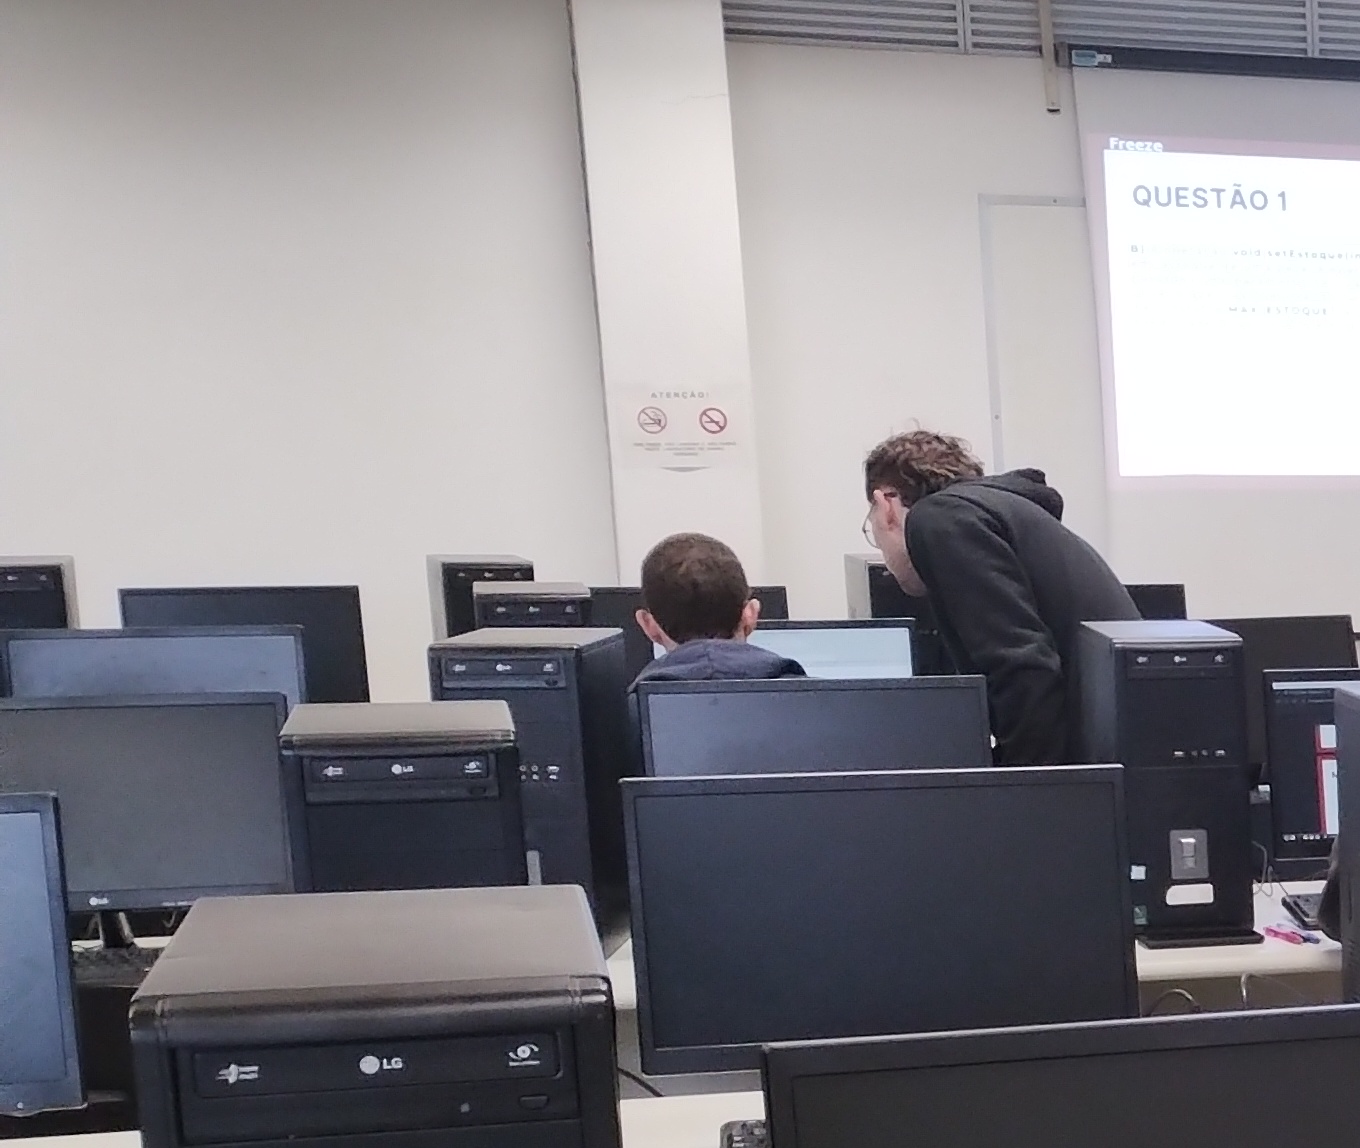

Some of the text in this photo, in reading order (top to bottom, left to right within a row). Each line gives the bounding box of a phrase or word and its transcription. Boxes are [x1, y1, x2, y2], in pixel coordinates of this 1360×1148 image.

[1108, 136, 1164, 153] Freeze
[1132, 183, 1288, 212] QUESTÃO 1
[382, 1057, 403, 1070] LG
